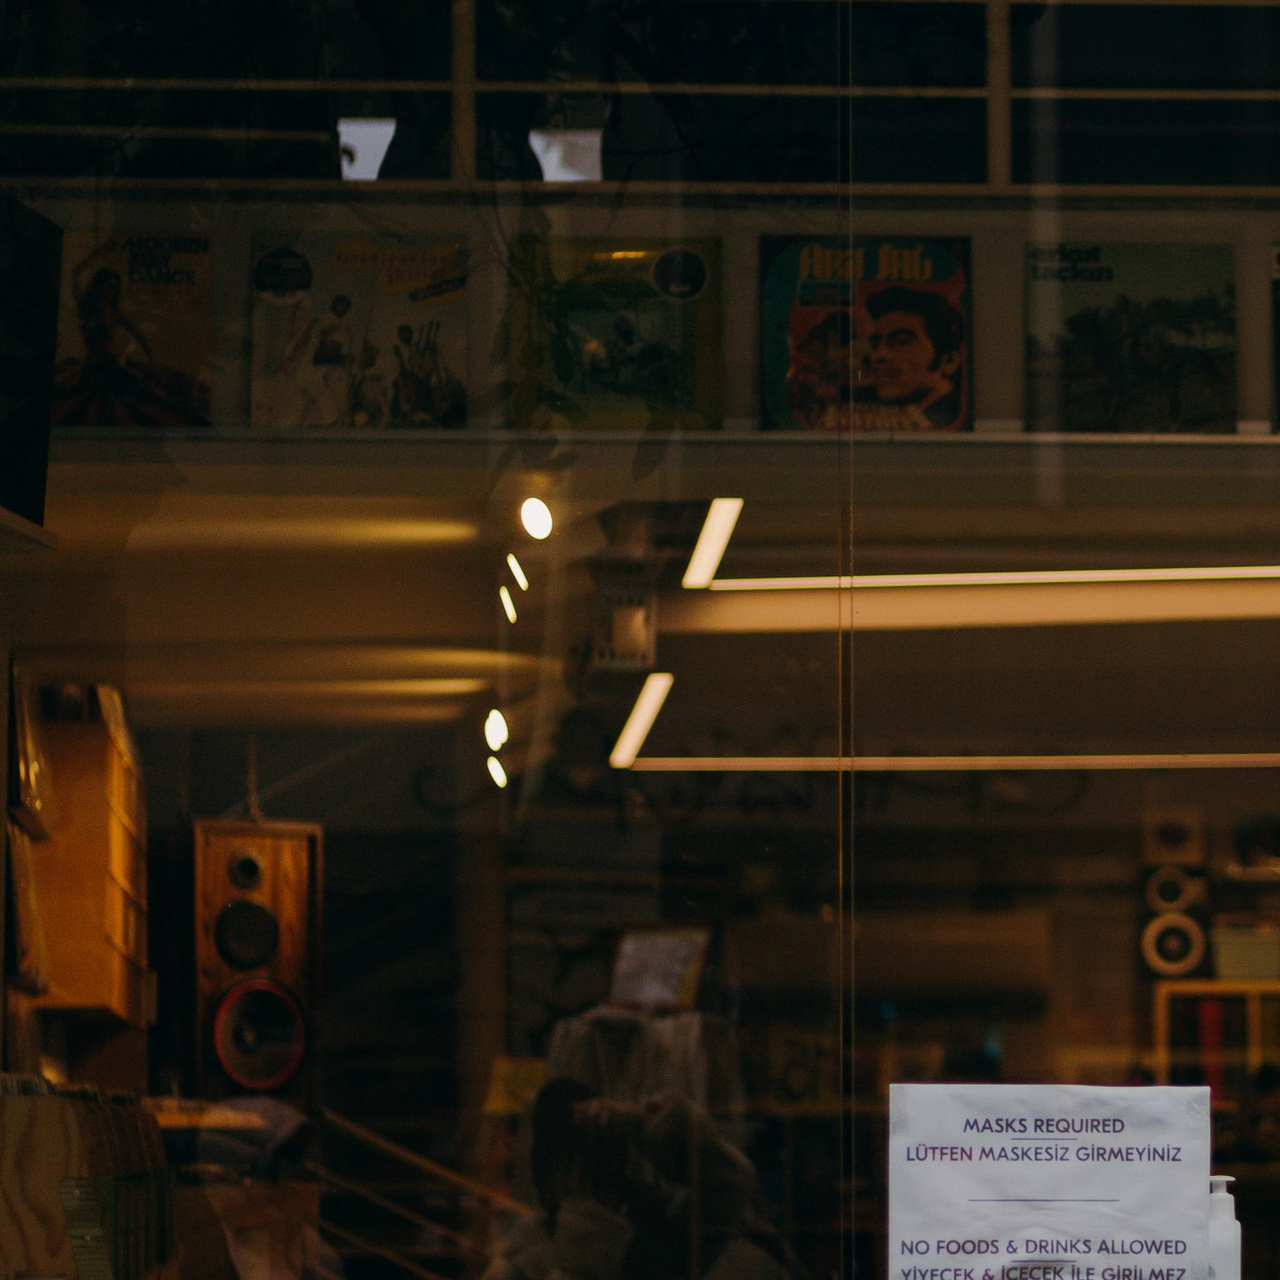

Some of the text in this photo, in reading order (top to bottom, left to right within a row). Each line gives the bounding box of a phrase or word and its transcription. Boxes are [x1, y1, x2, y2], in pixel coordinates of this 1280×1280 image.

[963, 1118, 1125, 1134] MASKS REQUIRED
[906, 1144, 1182, 1162] LÜTFEN MASKESİZ GİRMEYİNİZ
[900, 1239, 1188, 1255] NO FOODS & DRINKS ALLOWED
